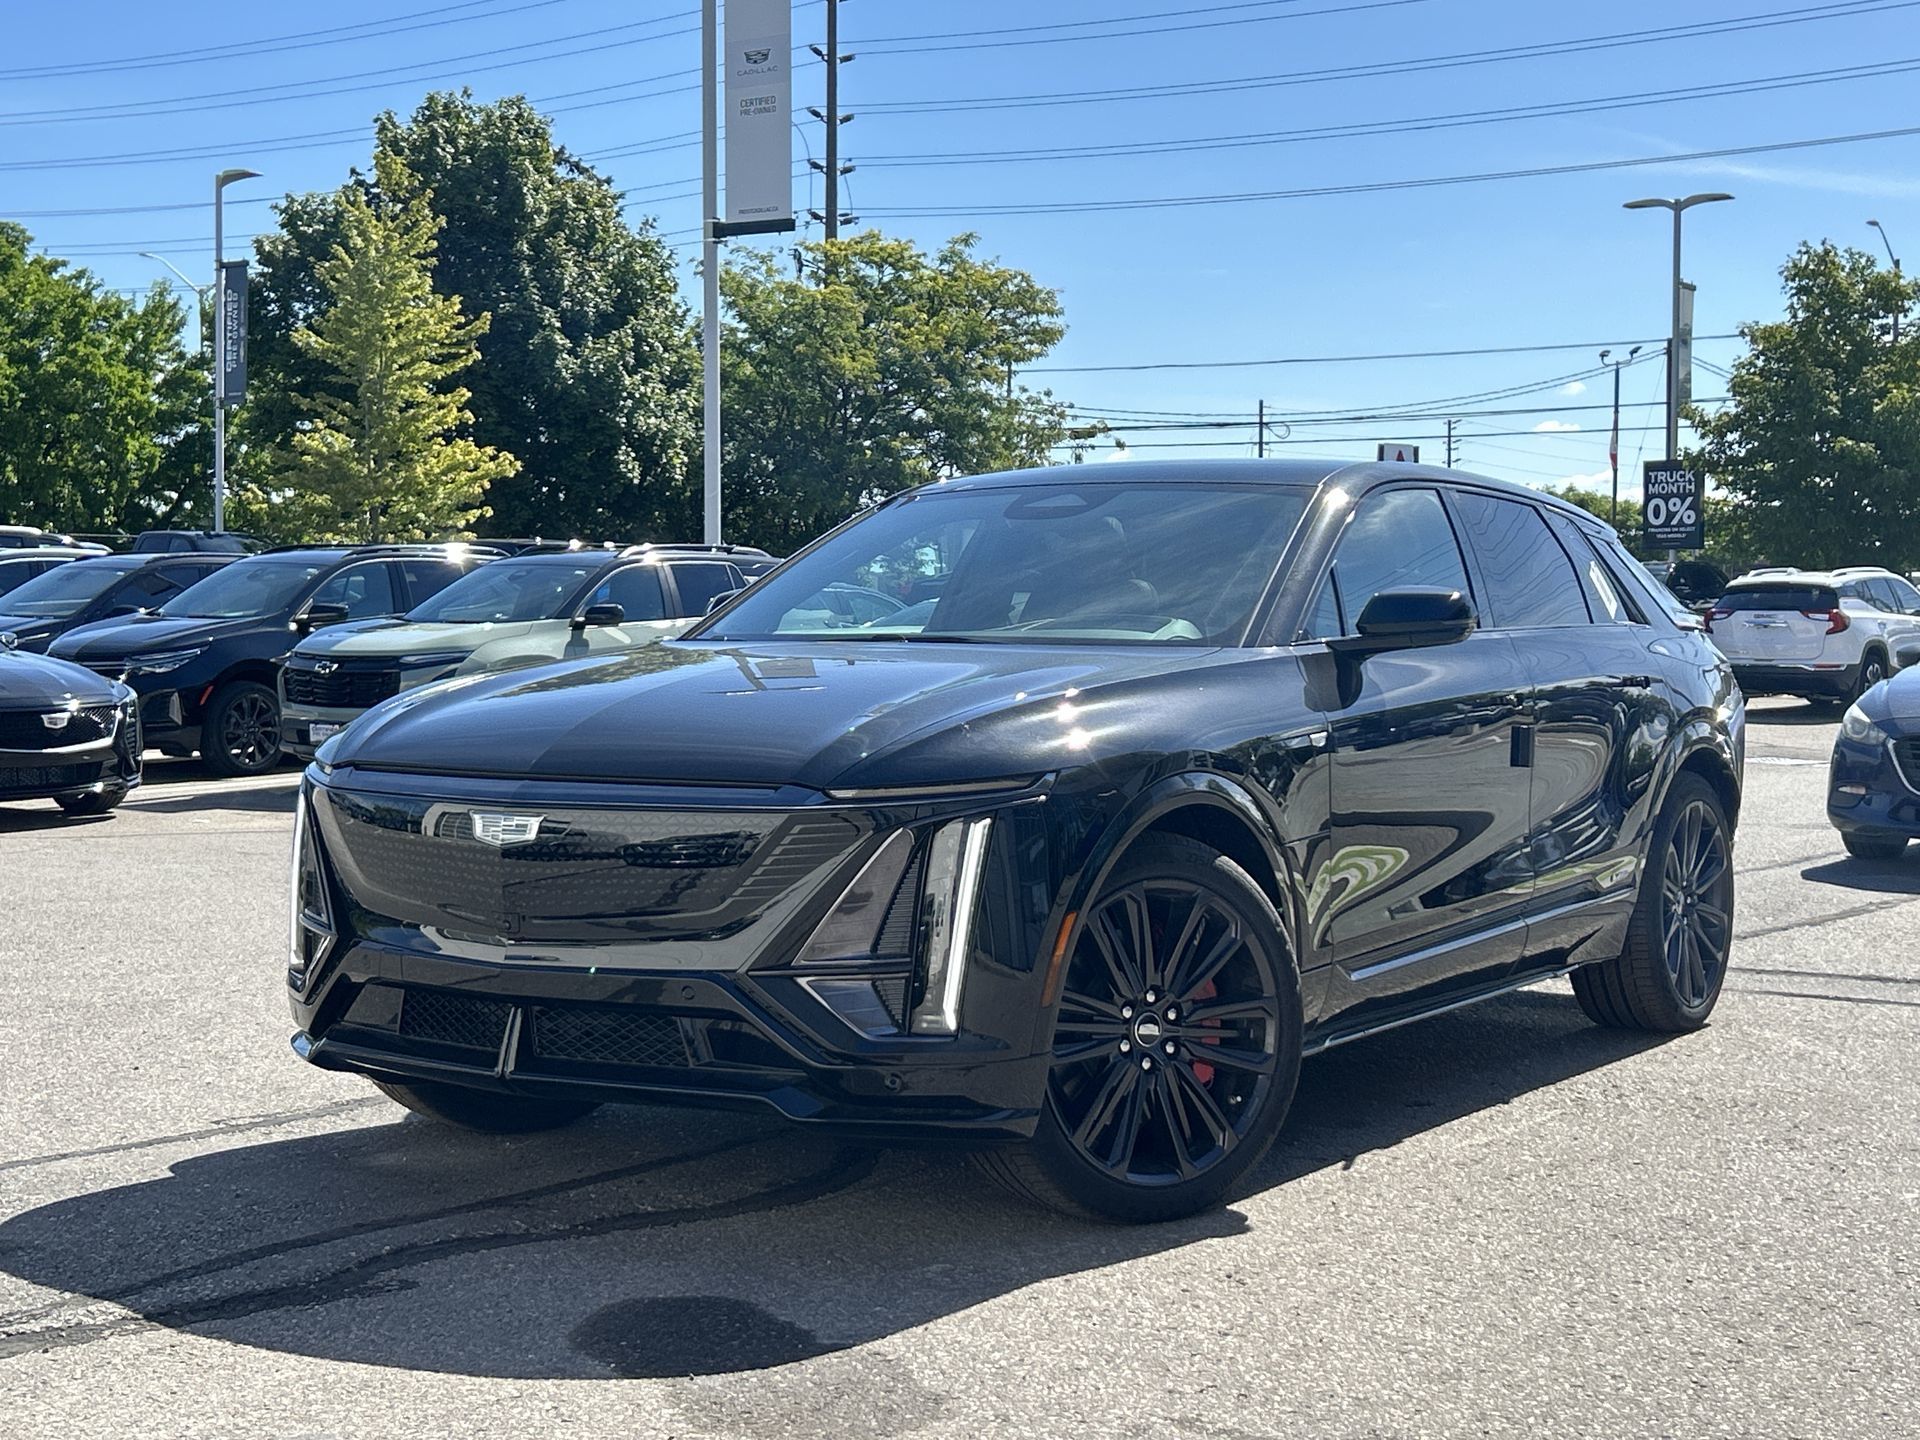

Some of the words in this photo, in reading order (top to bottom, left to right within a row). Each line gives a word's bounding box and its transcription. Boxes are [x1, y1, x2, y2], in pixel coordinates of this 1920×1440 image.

[736, 65, 778, 76] CADILLAC
[740, 95, 776, 108] CERTIFIED
[740, 105, 776, 116] PRE-OWNED
[1648, 470, 1695, 483] TRUCK
[1648, 482, 1695, 494] MONTH
[1647, 496, 1696, 526] 0%
